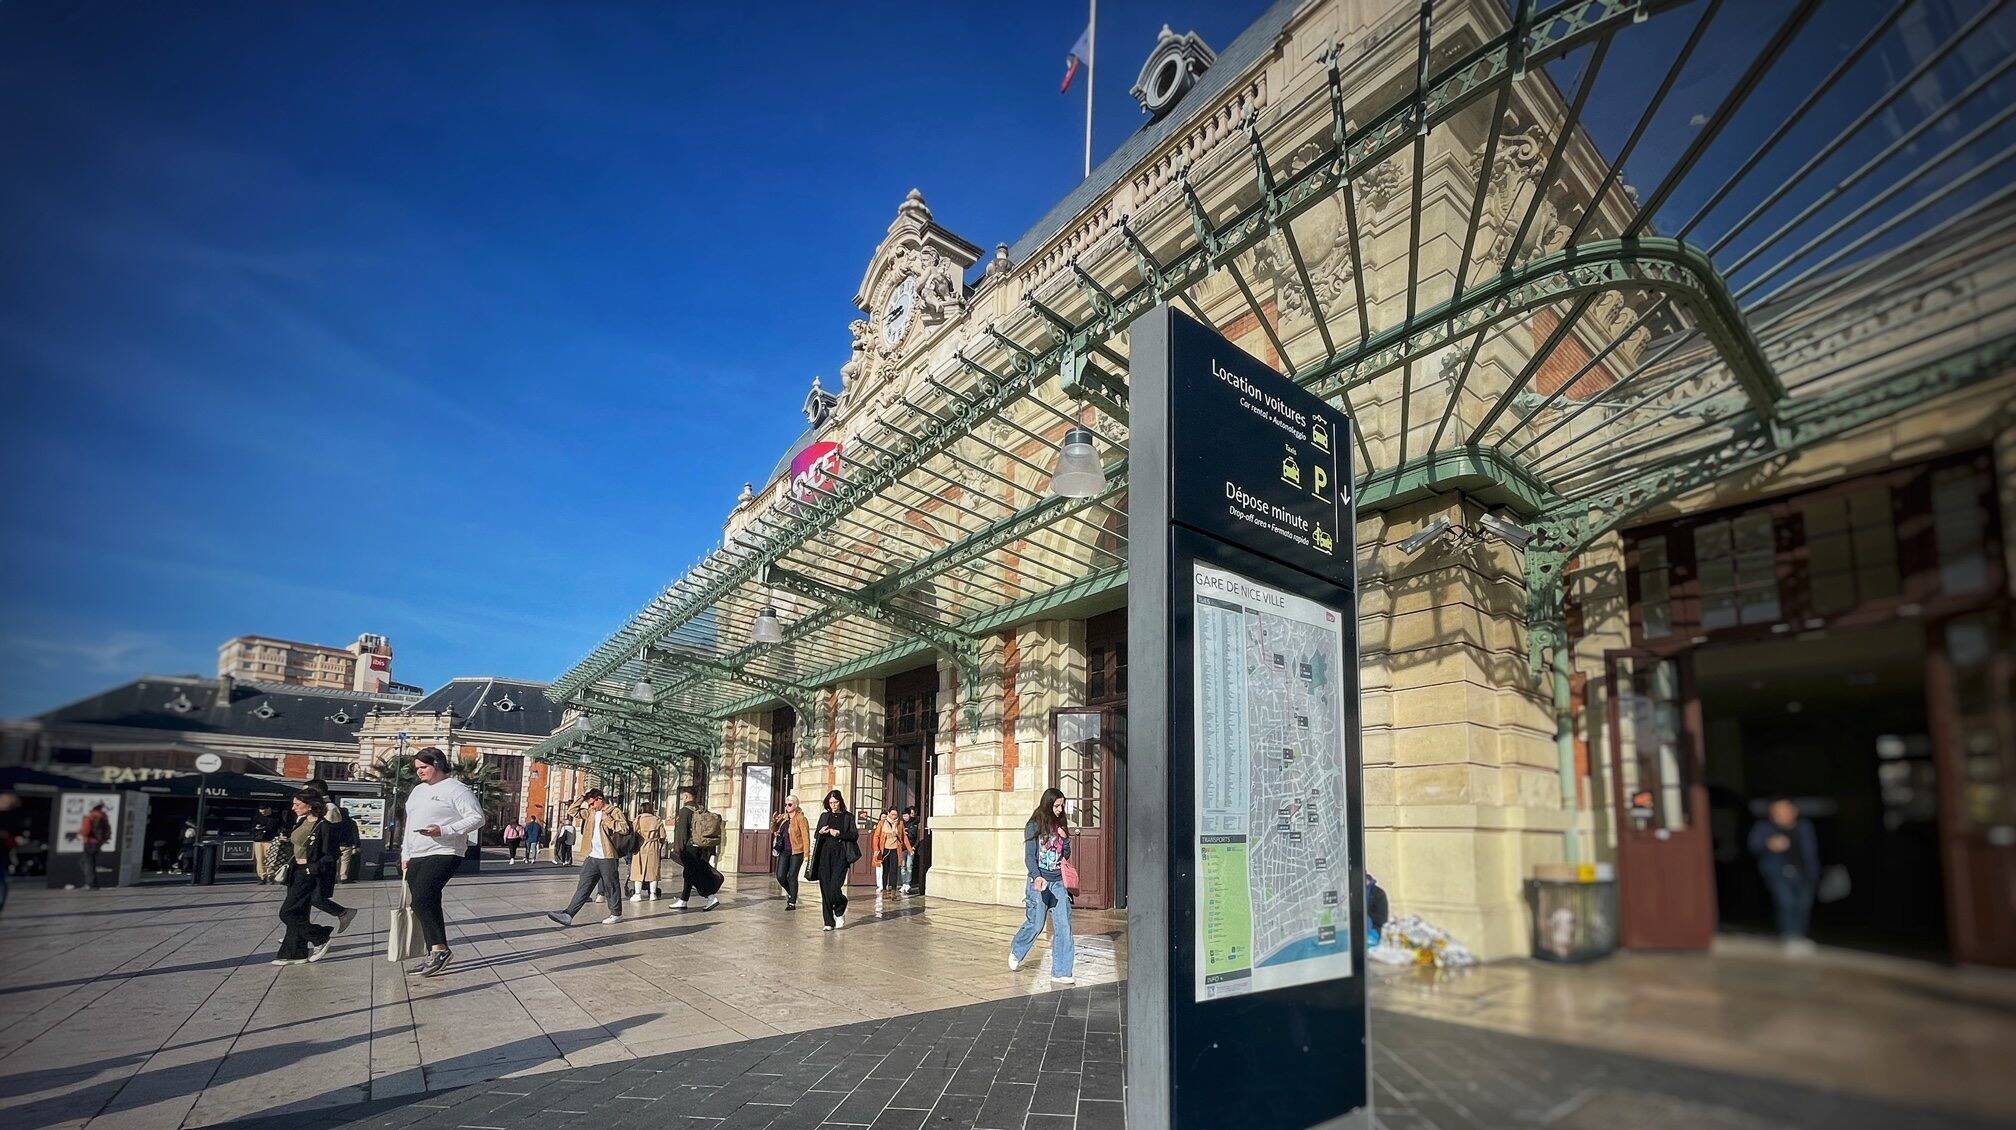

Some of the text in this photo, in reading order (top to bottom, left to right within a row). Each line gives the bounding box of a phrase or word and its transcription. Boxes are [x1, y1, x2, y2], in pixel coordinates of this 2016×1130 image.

[1212, 358, 1307, 428] Location voitures
[1240, 397, 1251, 409] Car
[1251, 405, 1268, 420] rental
[1285, 443, 1297, 456] Taxis
[1314, 464, 1328, 494] P
[1226, 481, 1309, 532] Dépose minute
[1229, 505, 1255, 523] Drop-off
[1254, 517, 1267, 529] area
[1195, 573, 1285, 608] GARE DE NICE VILLE
[372, 659, 385, 667] ibis
